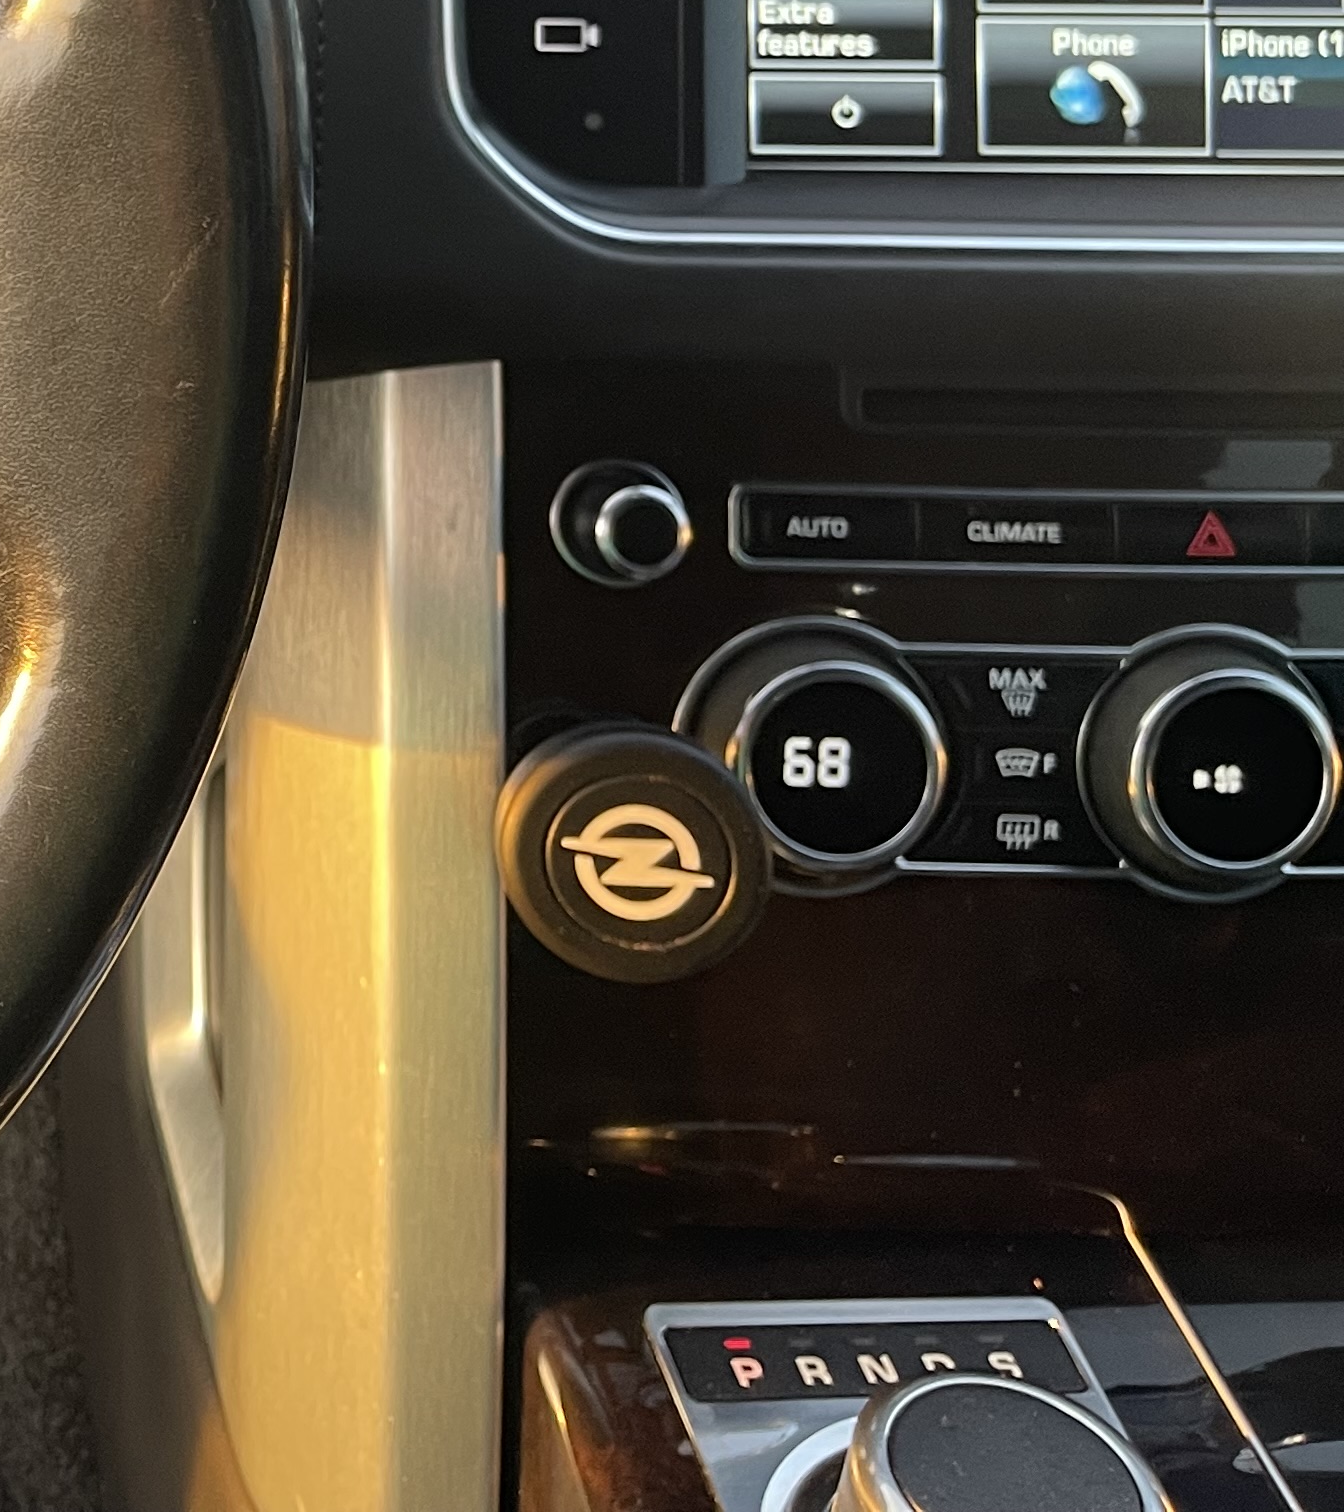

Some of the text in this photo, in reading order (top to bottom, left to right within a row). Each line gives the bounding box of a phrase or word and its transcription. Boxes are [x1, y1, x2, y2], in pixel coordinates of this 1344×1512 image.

[757, 1, 835, 25] Extra
[757, 31, 877, 58] features
[1053, 29, 1138, 57] Phone
[1221, 28, 1312, 57] iPhone
[1221, 75, 1298, 104] AT&T
[787, 516, 848, 540] AUTO
[967, 521, 1063, 544] CLIMATE
[989, 667, 1047, 690] MAX
[782, 736, 852, 788] 68
[730, 1356, 764, 1388] P
[794, 1355, 834, 1386] R
[857, 1353, 899, 1384] N
